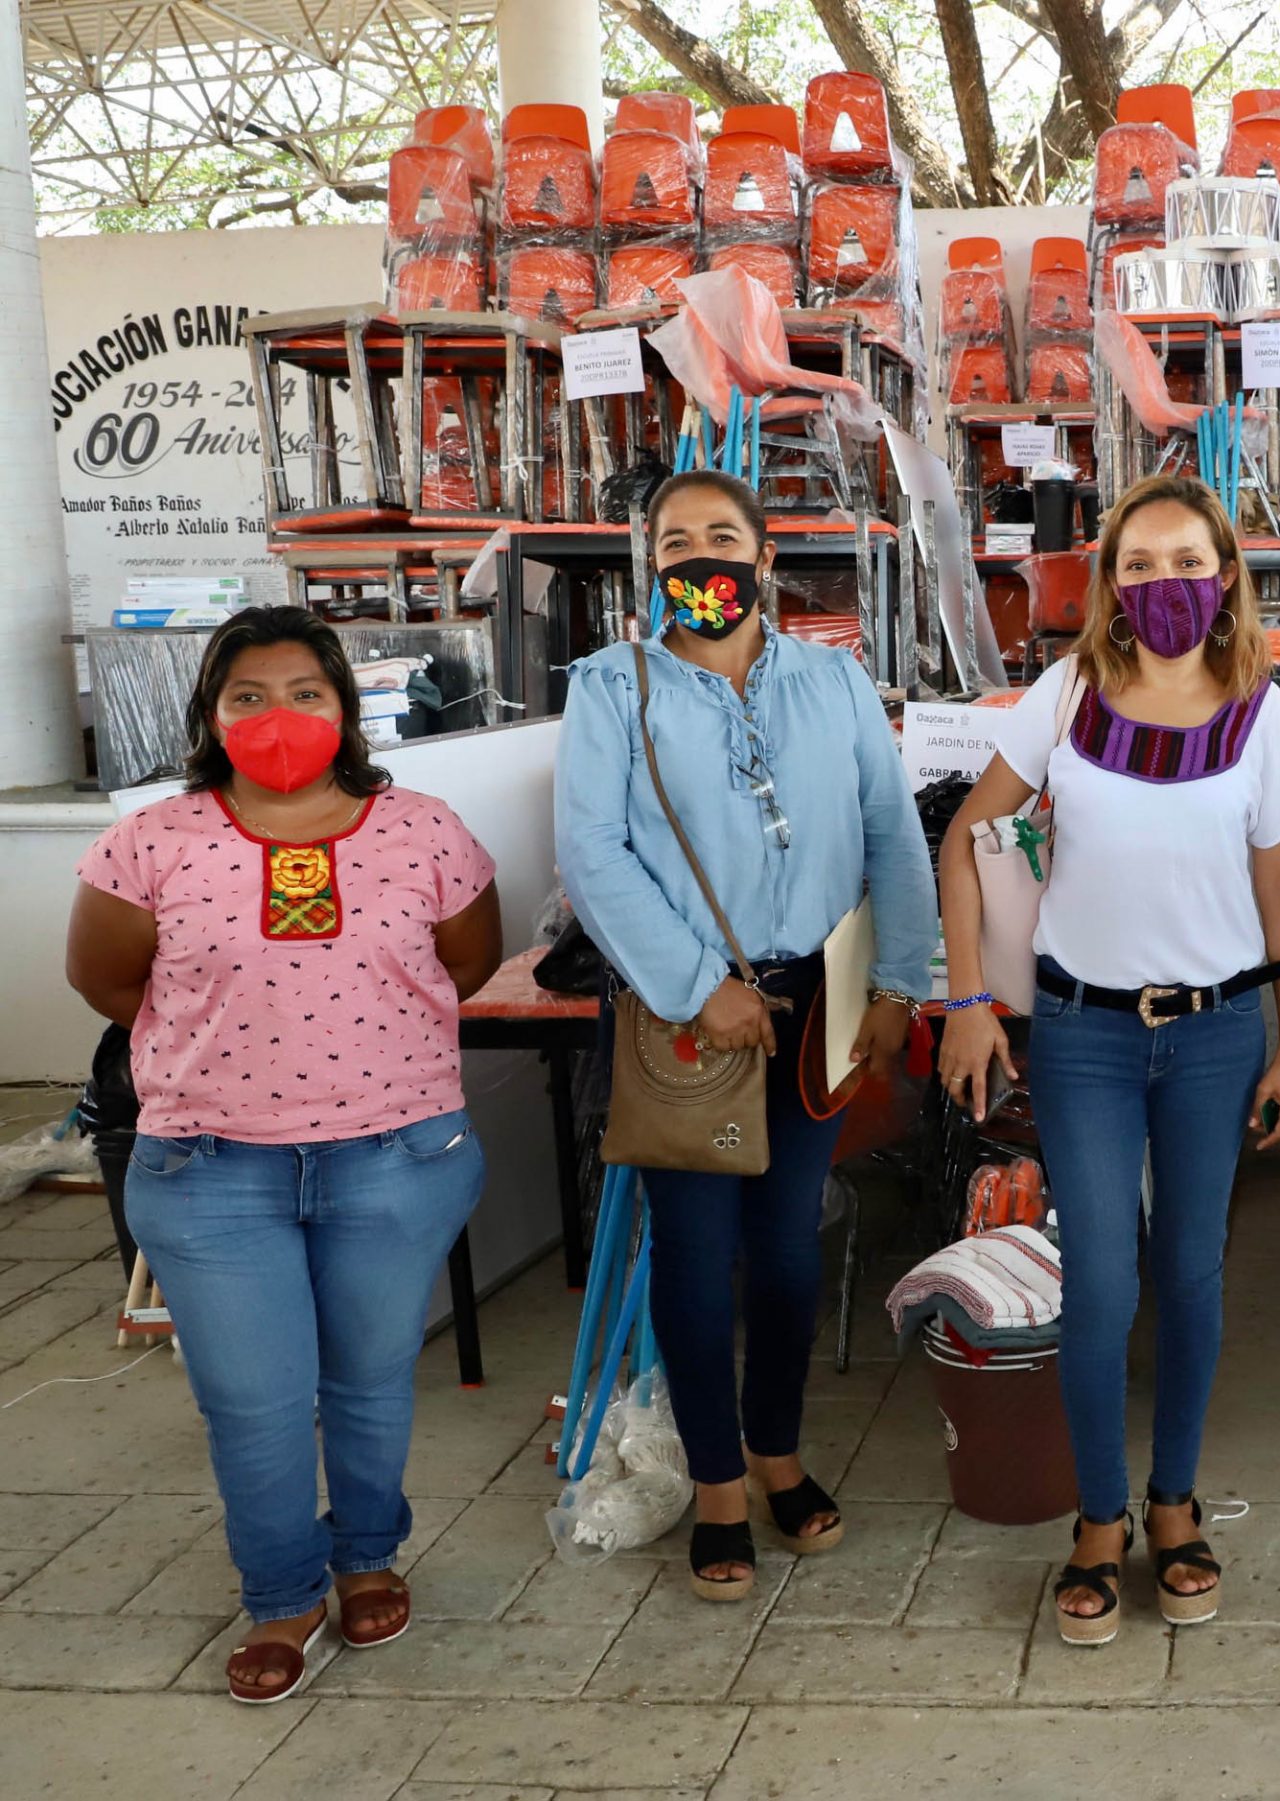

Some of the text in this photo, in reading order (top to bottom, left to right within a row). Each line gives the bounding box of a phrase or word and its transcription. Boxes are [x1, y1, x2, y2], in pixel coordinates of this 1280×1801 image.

[53, 305, 271, 432] OCIACIÓN GANA
[574, 358, 632, 371] BENITO JUAREZ
[83, 412, 161, 471] 60
[109, 495, 152, 512] Baños
[157, 495, 202, 512] Baños
[114, 518, 170, 536] Alberto
[926, 737, 964, 749] JARDIN
[967, 738, 981, 749] DE
